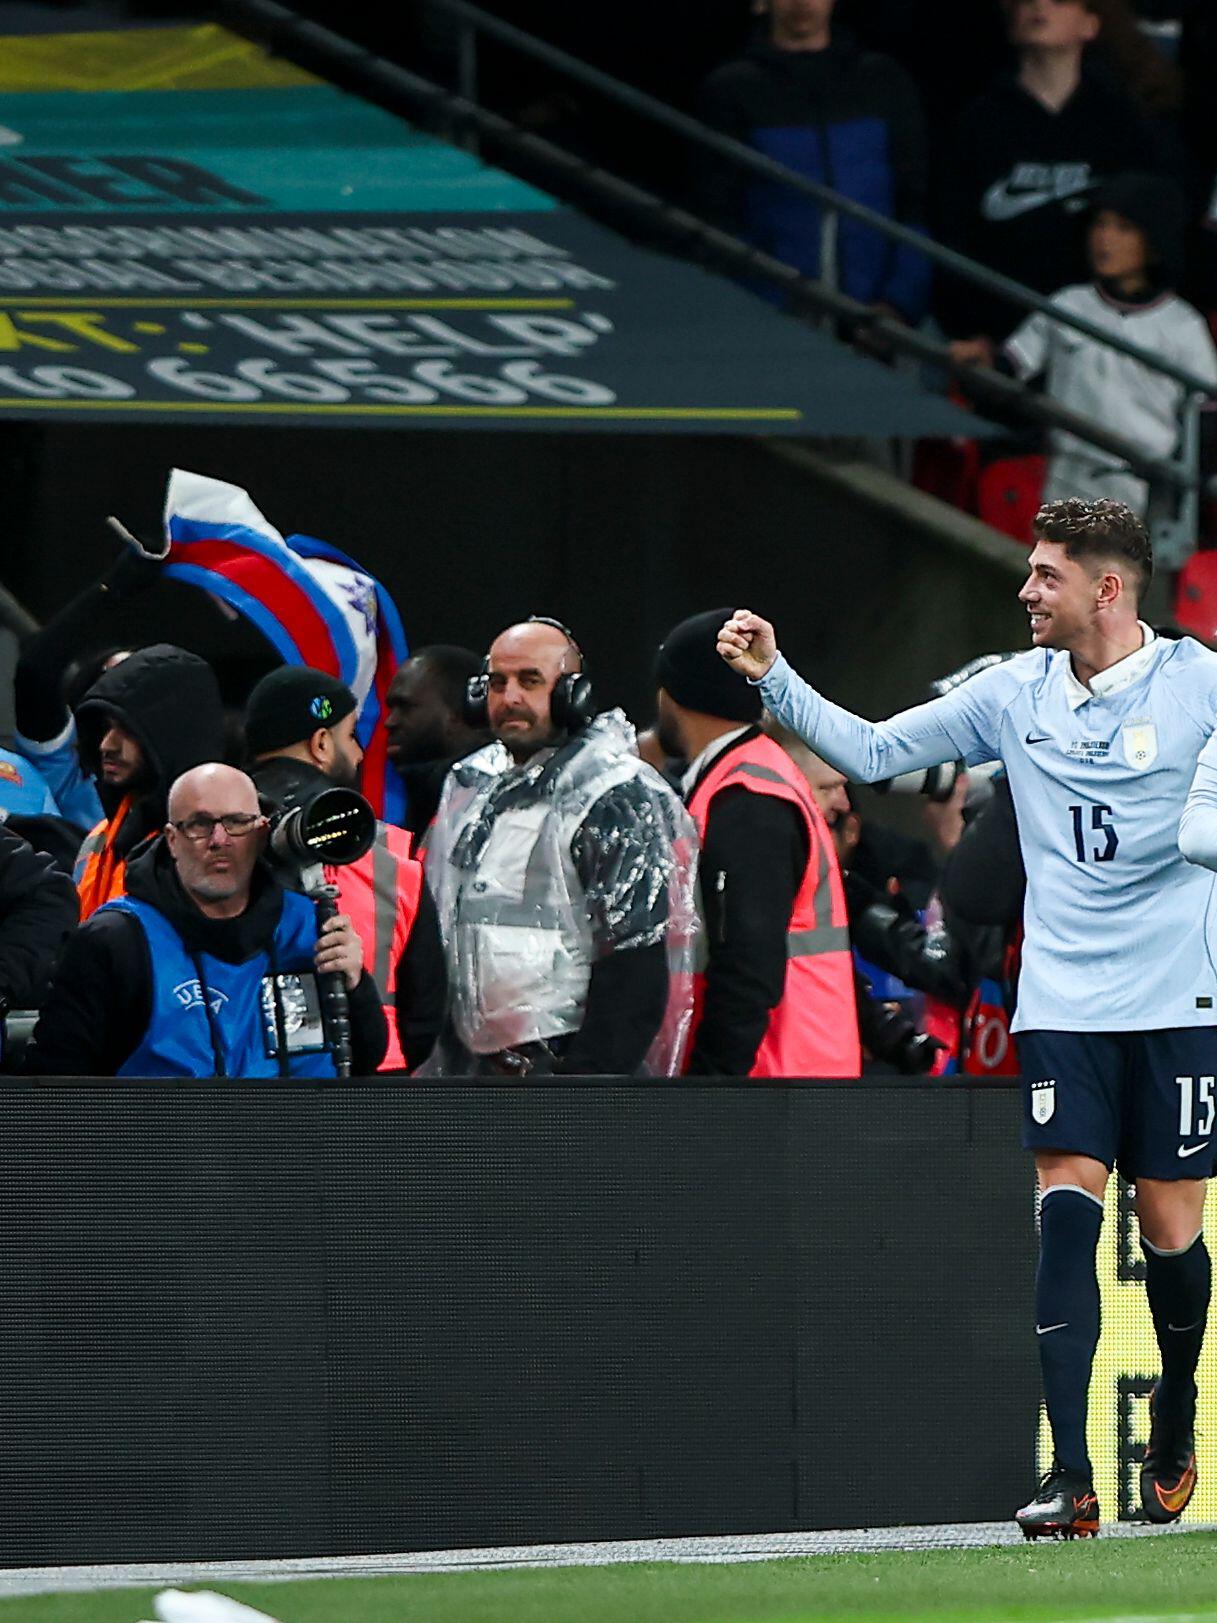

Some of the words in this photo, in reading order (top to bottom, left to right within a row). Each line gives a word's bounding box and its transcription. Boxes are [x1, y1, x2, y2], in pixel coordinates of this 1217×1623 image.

[146, 357, 617, 405] 66566
[1069, 805, 1119, 862] 15
[175, 984, 223, 1015] UEA
[1175, 1076, 1216, 1136] 15
